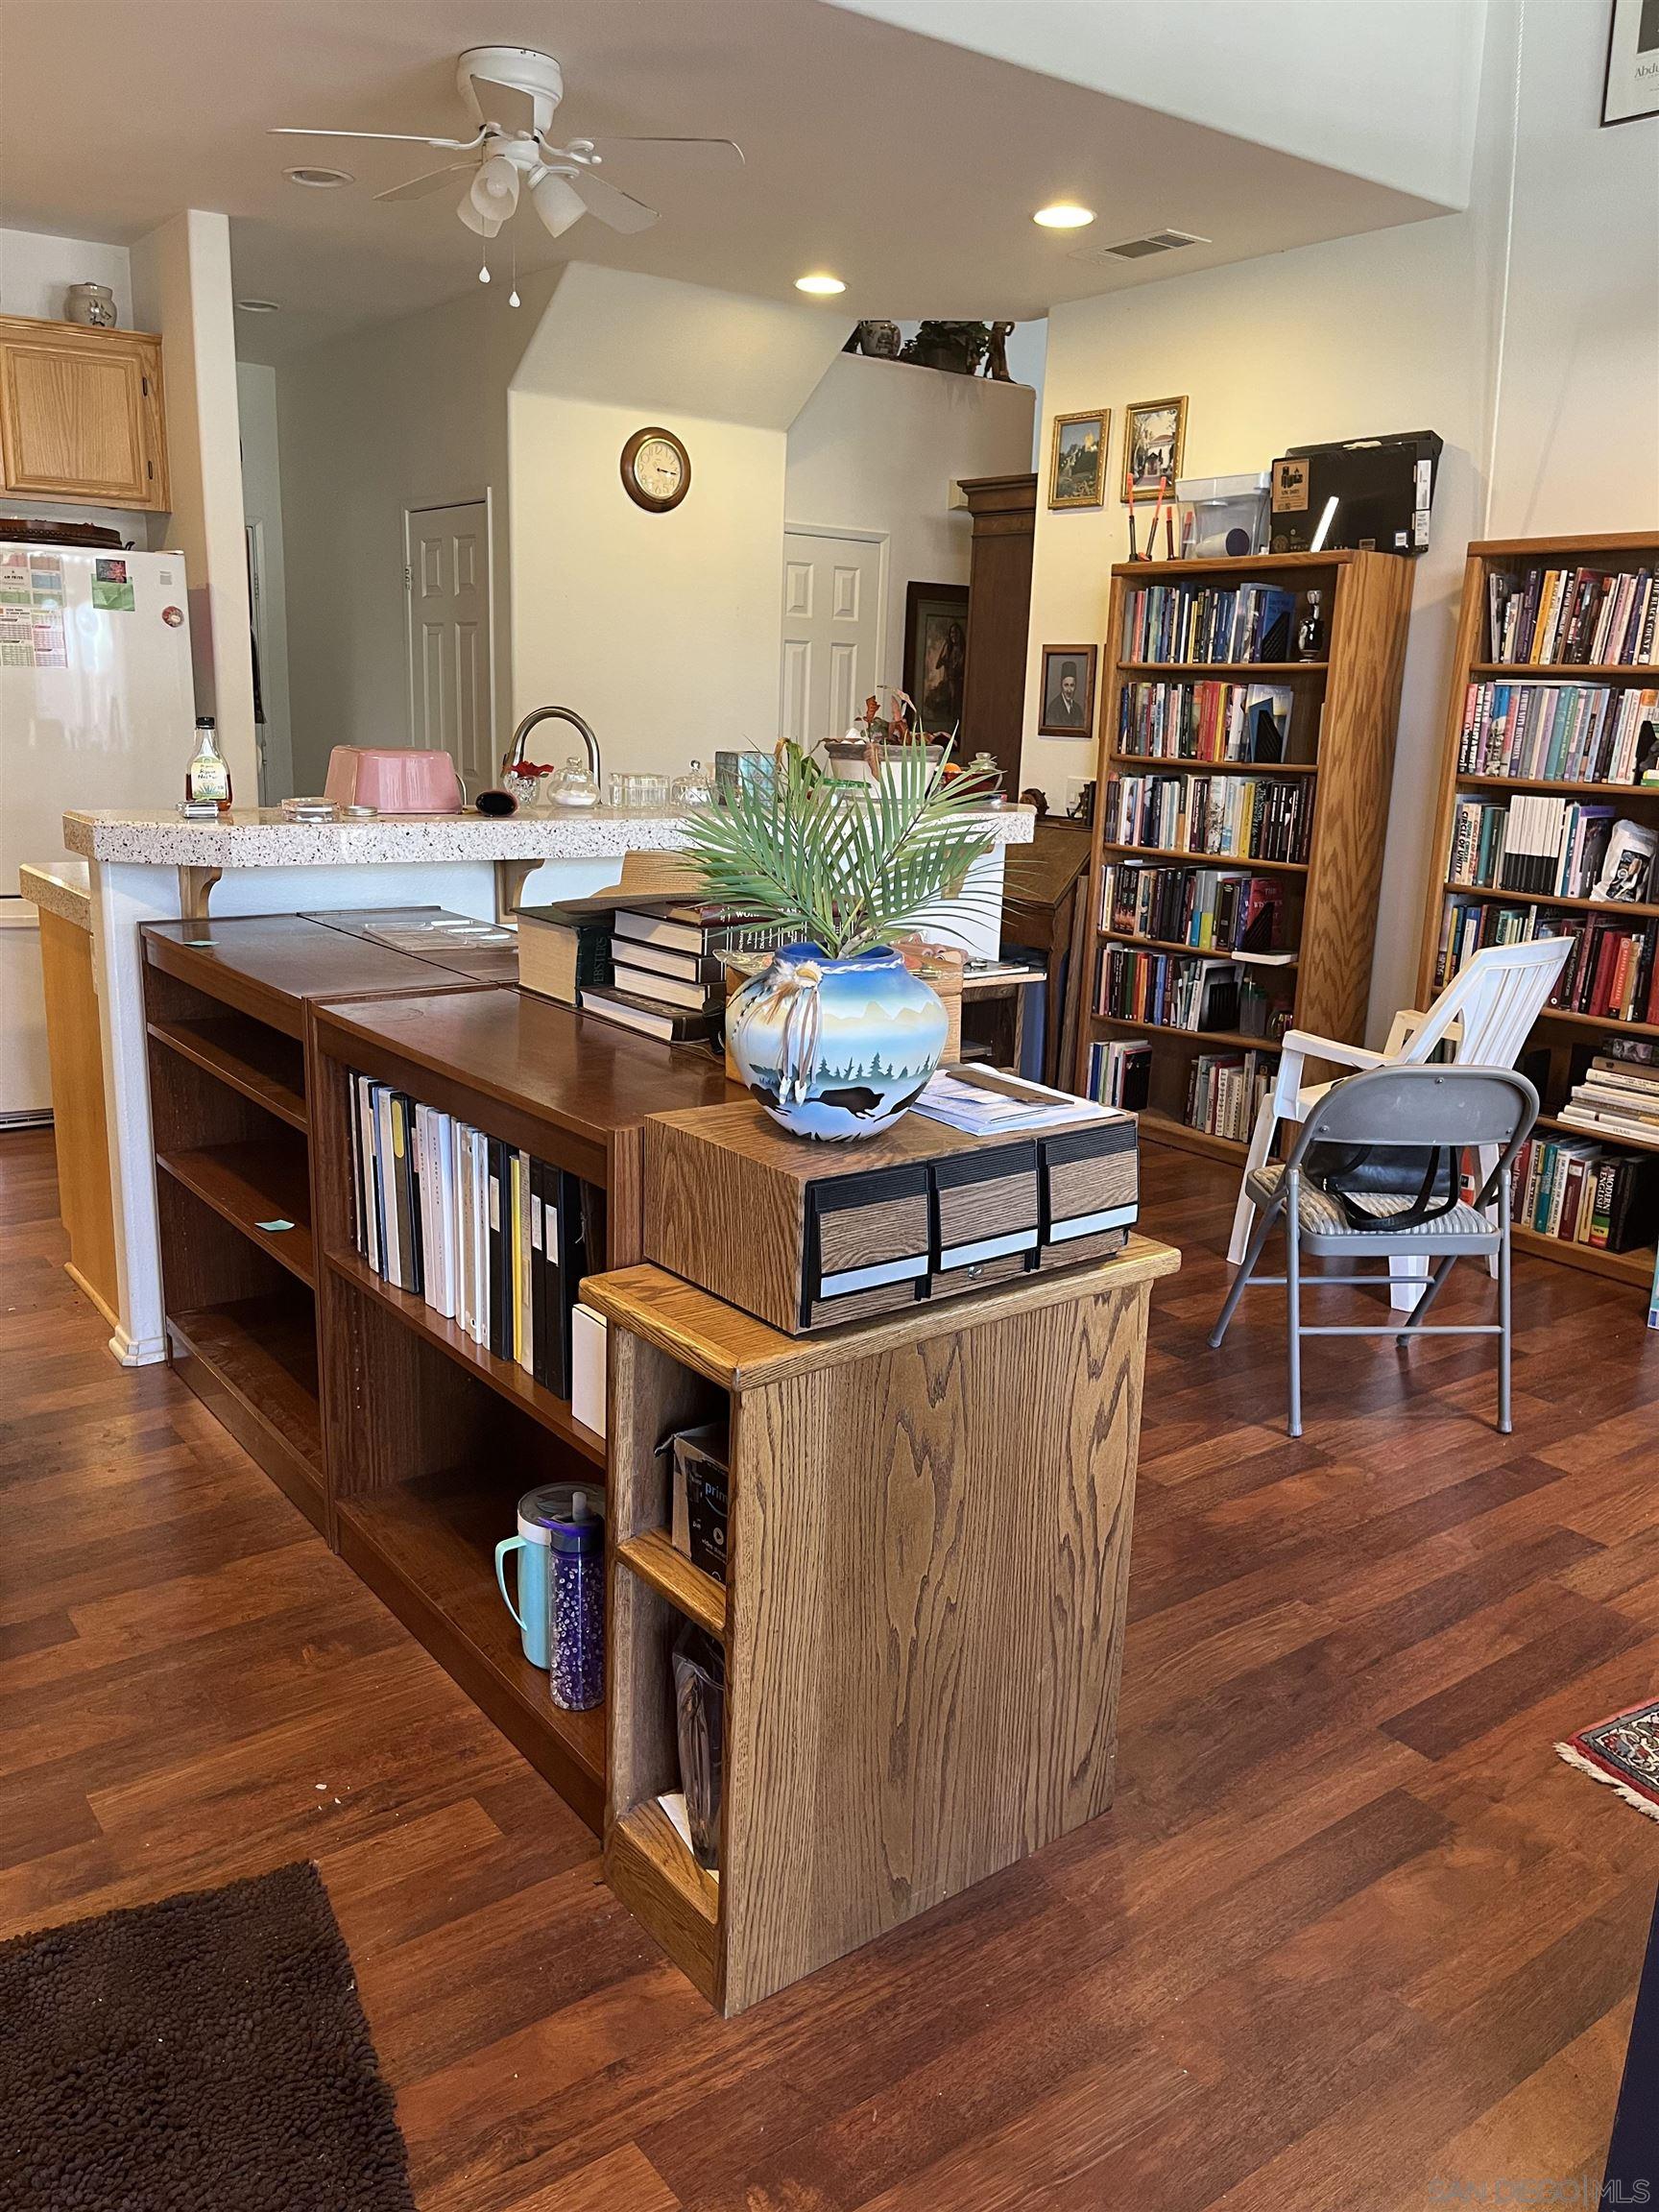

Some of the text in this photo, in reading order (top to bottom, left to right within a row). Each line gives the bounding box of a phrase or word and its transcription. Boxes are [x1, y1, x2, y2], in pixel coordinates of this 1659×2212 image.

[1648, 596, 1658, 621] BLACK
[1643, 623, 1653, 649] COUNT
[1455, 811, 1468, 876] CIRCLE OF UNITY
[1471, 843, 1476, 853] OF
[1596, 1171, 1607, 1209] ENGLISH
[1602, 1172, 1615, 1210] MODERN
[705, 1481, 729, 1503] prim
